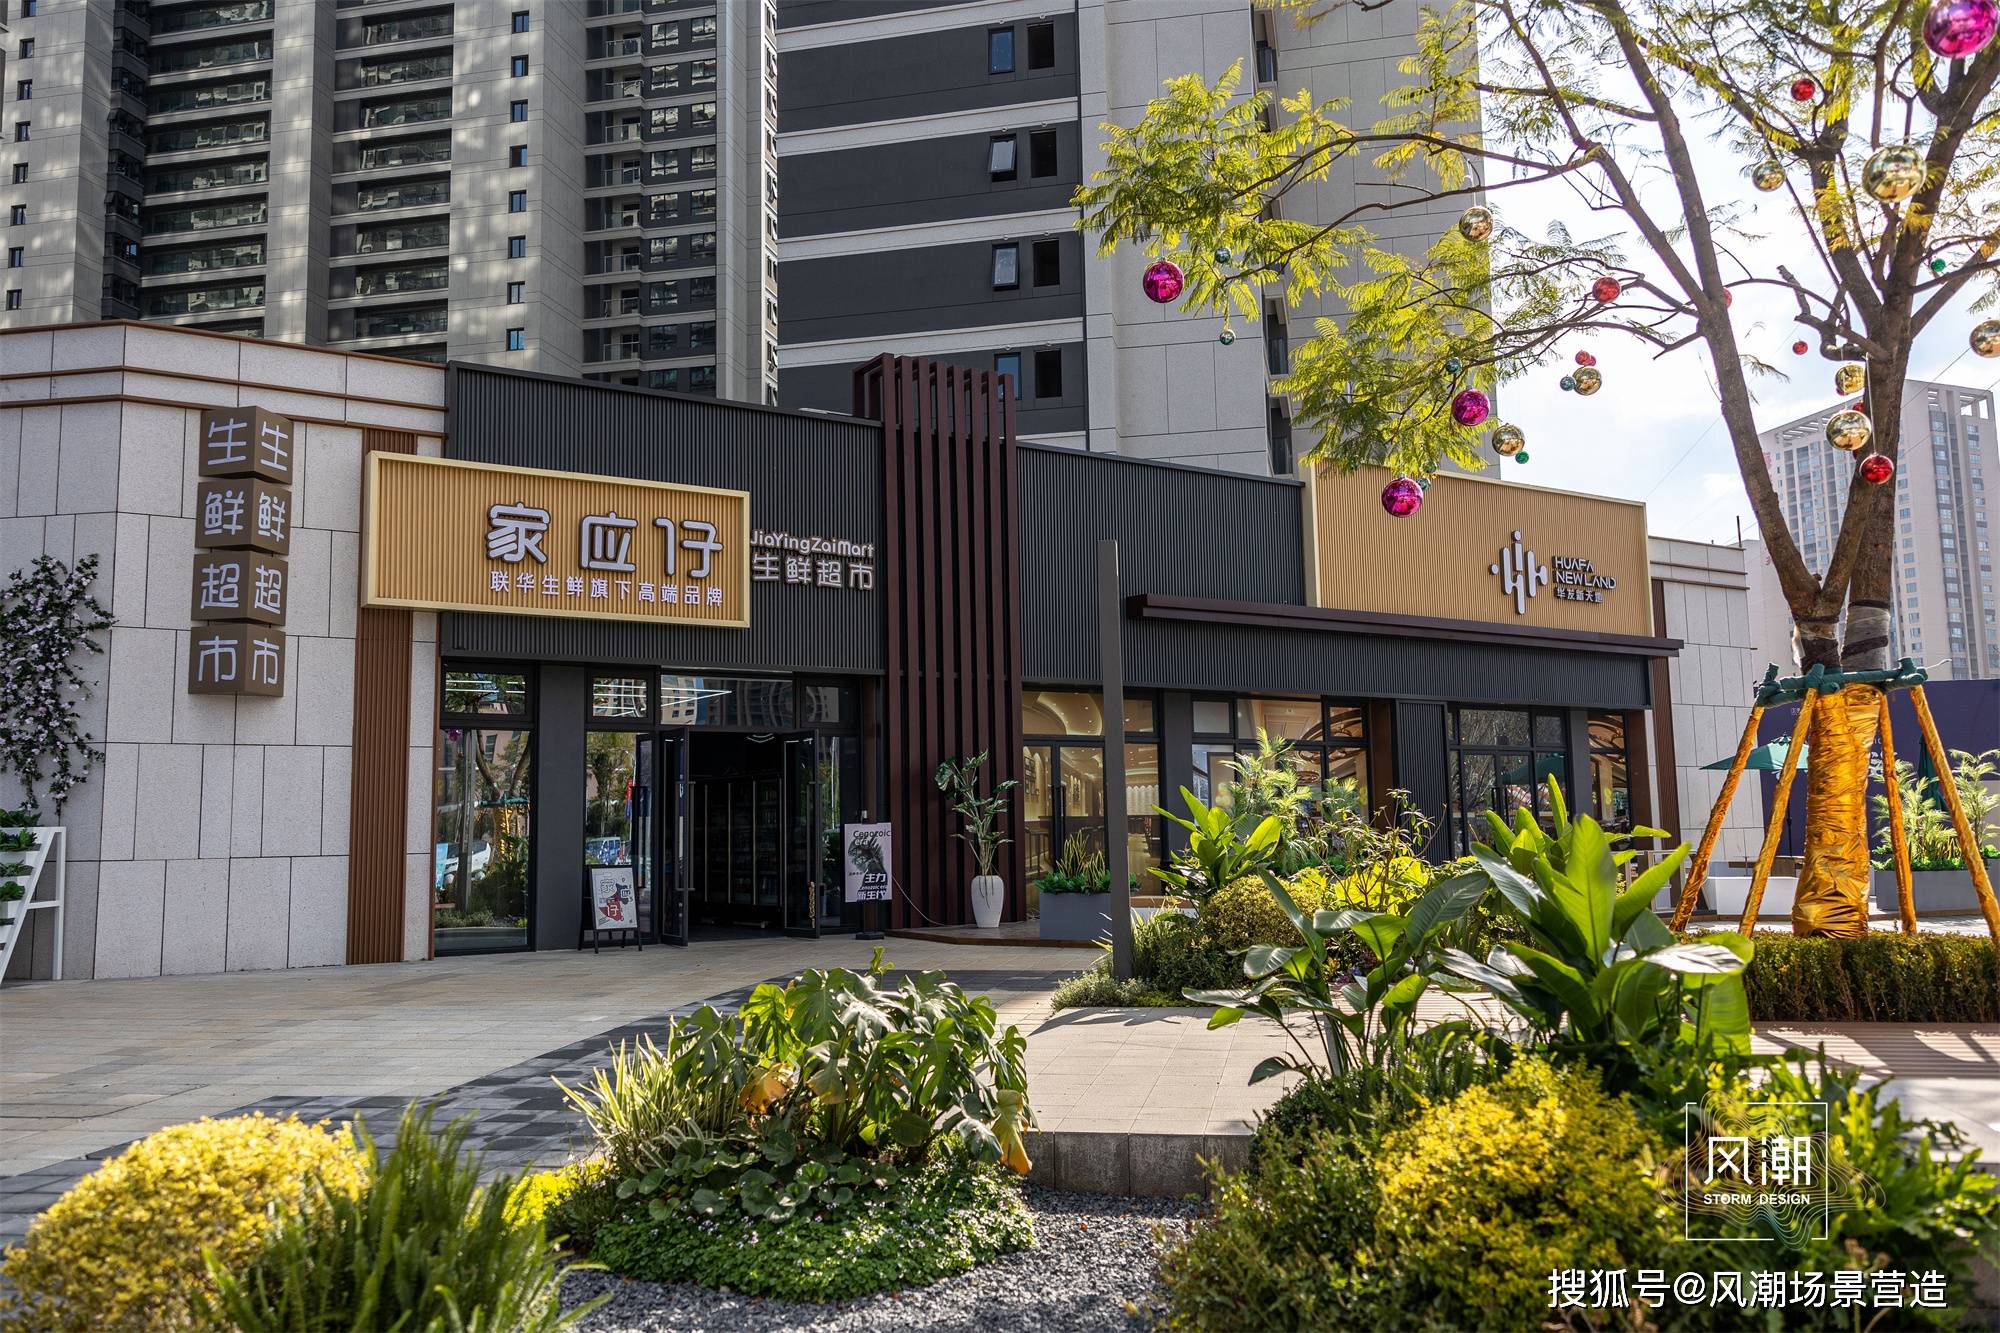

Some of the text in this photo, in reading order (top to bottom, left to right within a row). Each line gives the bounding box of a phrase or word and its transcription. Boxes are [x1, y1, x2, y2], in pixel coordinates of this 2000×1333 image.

[198, 418, 248, 682] 生鲜超市
[253, 421, 289, 685] 生鲜超市
[487, 502, 724, 579] 家应仔
[750, 530, 875, 558] JiaYingZaiMart
[753, 553, 873, 590] 生鲜超市
[1554, 556, 1595, 573] HUAFA
[490, 570, 724, 608] 联华生鲜旗下高端品牌
